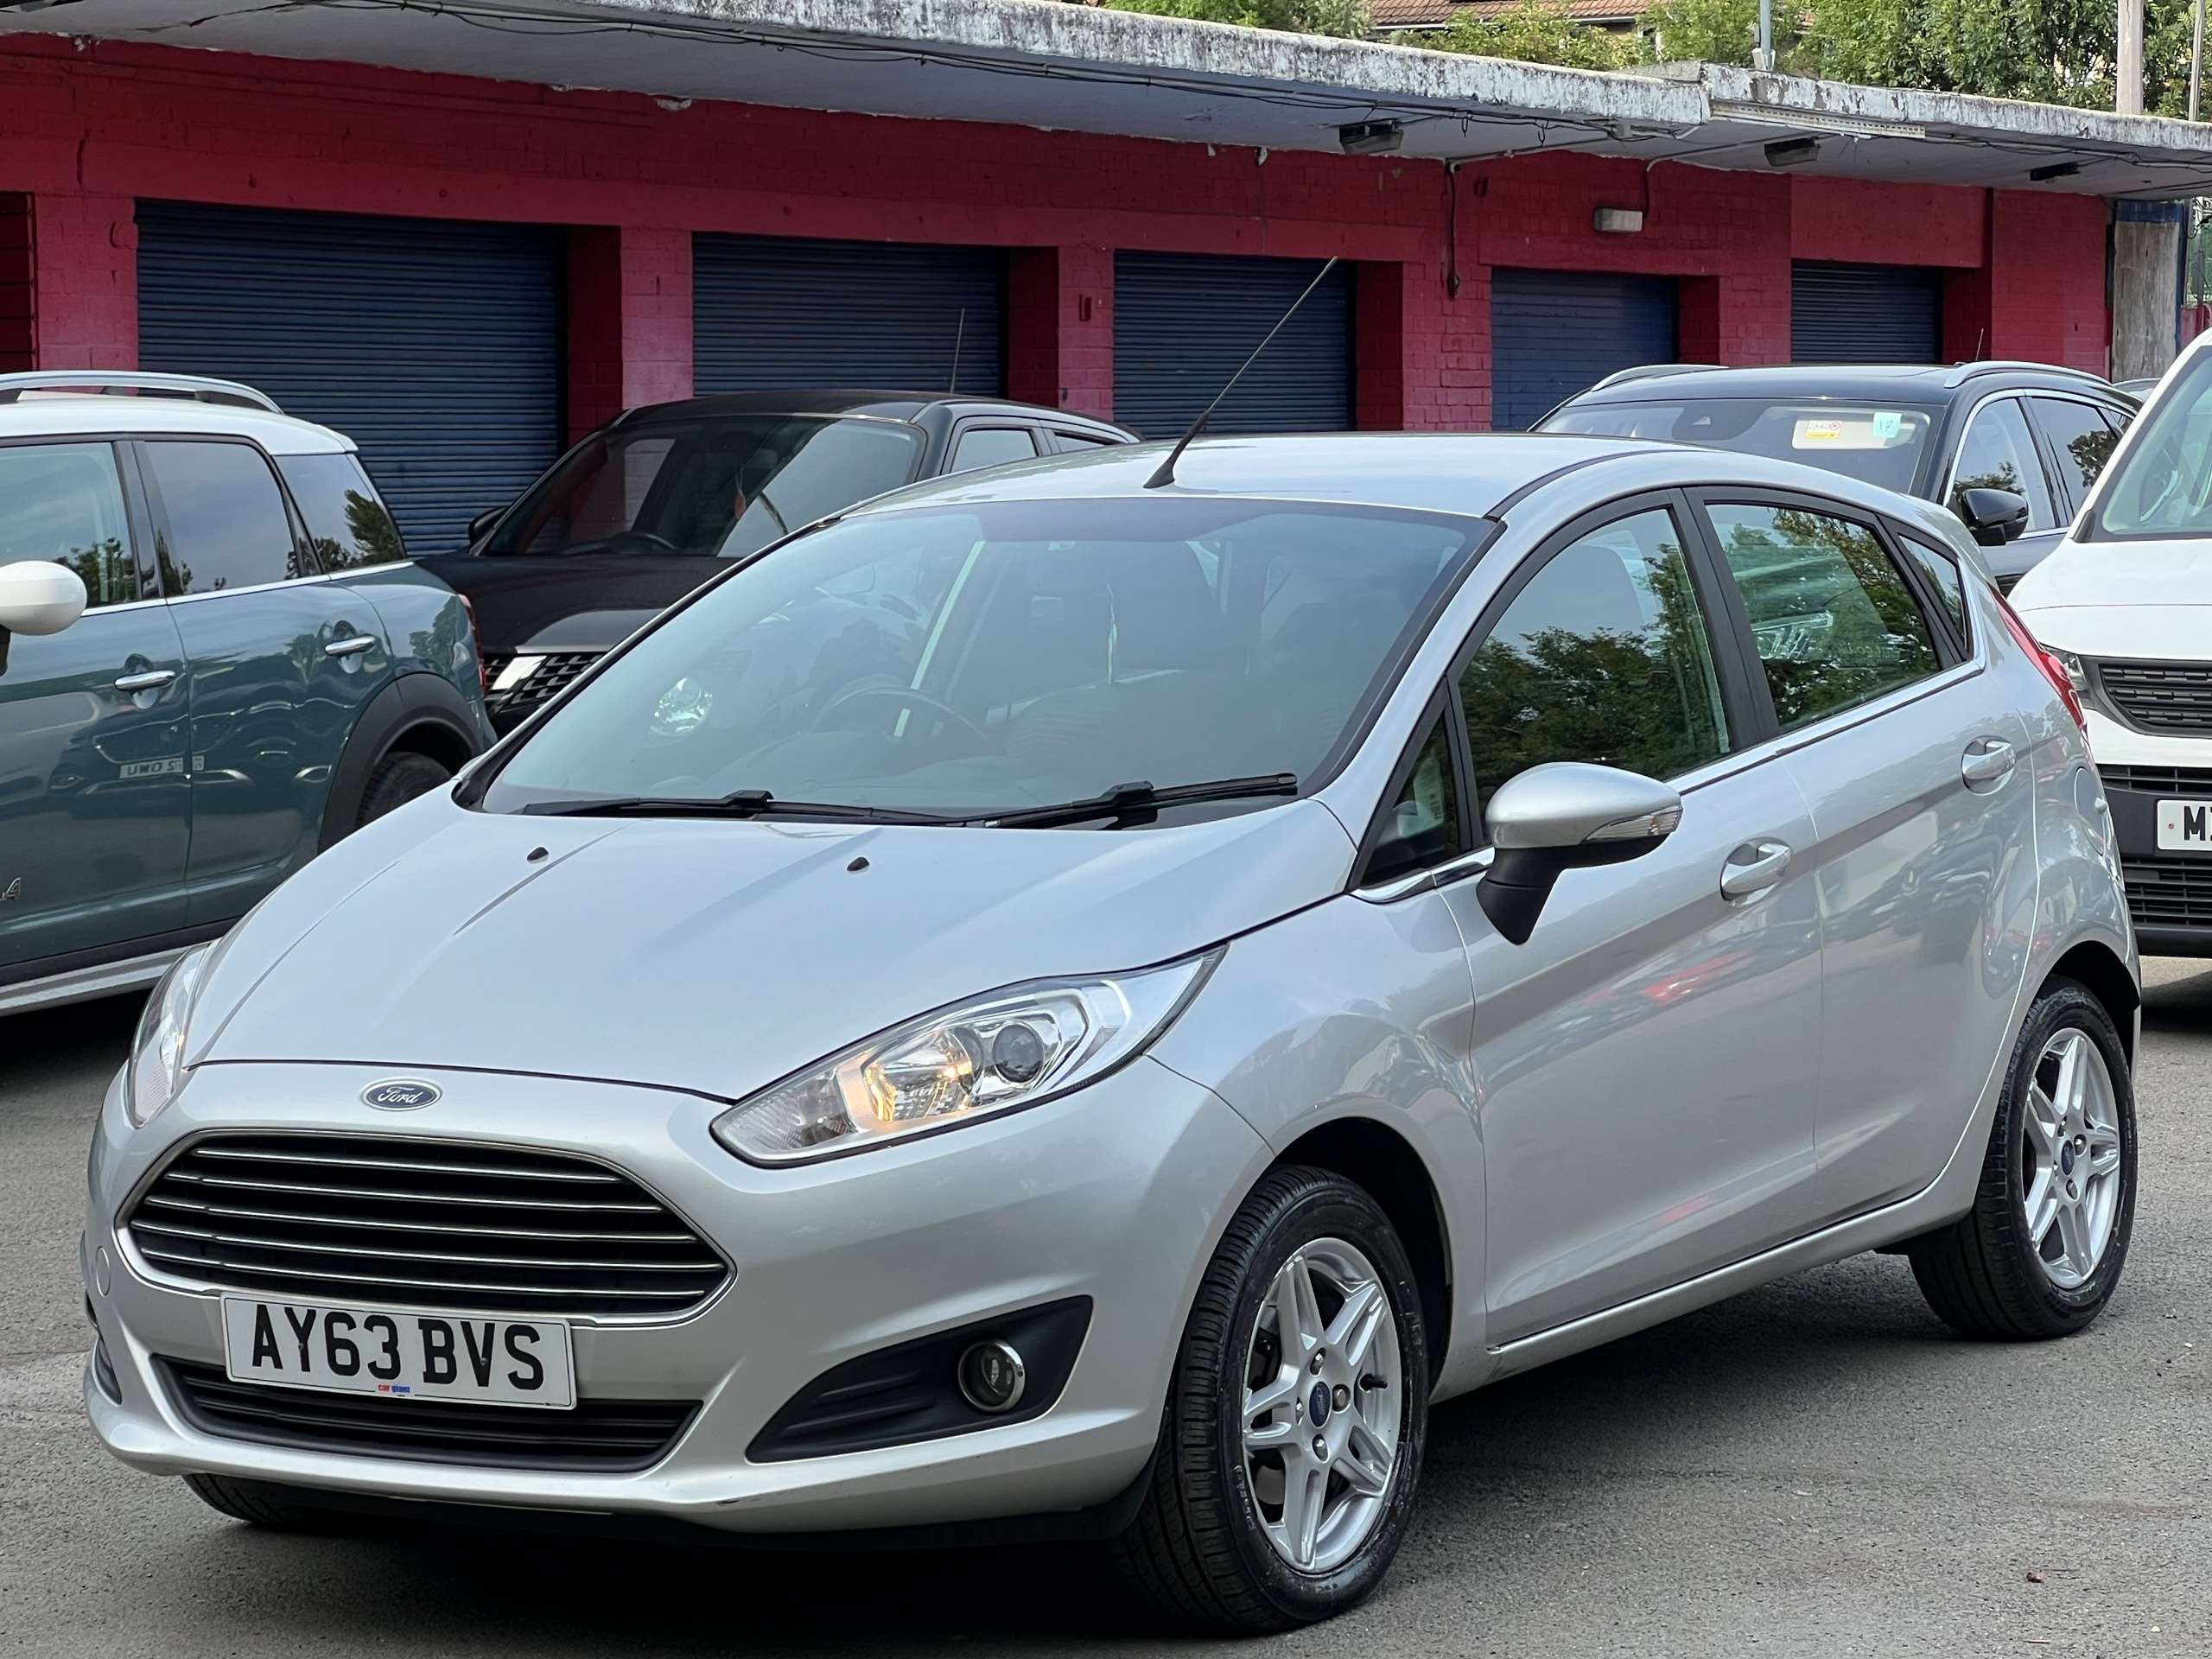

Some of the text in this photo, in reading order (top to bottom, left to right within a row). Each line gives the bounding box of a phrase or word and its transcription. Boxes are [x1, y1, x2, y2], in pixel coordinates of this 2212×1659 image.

[2184, 806, 2212, 842] M
[378, 1086, 423, 1103] Ford
[251, 1304, 544, 1391] AY63 BVS
